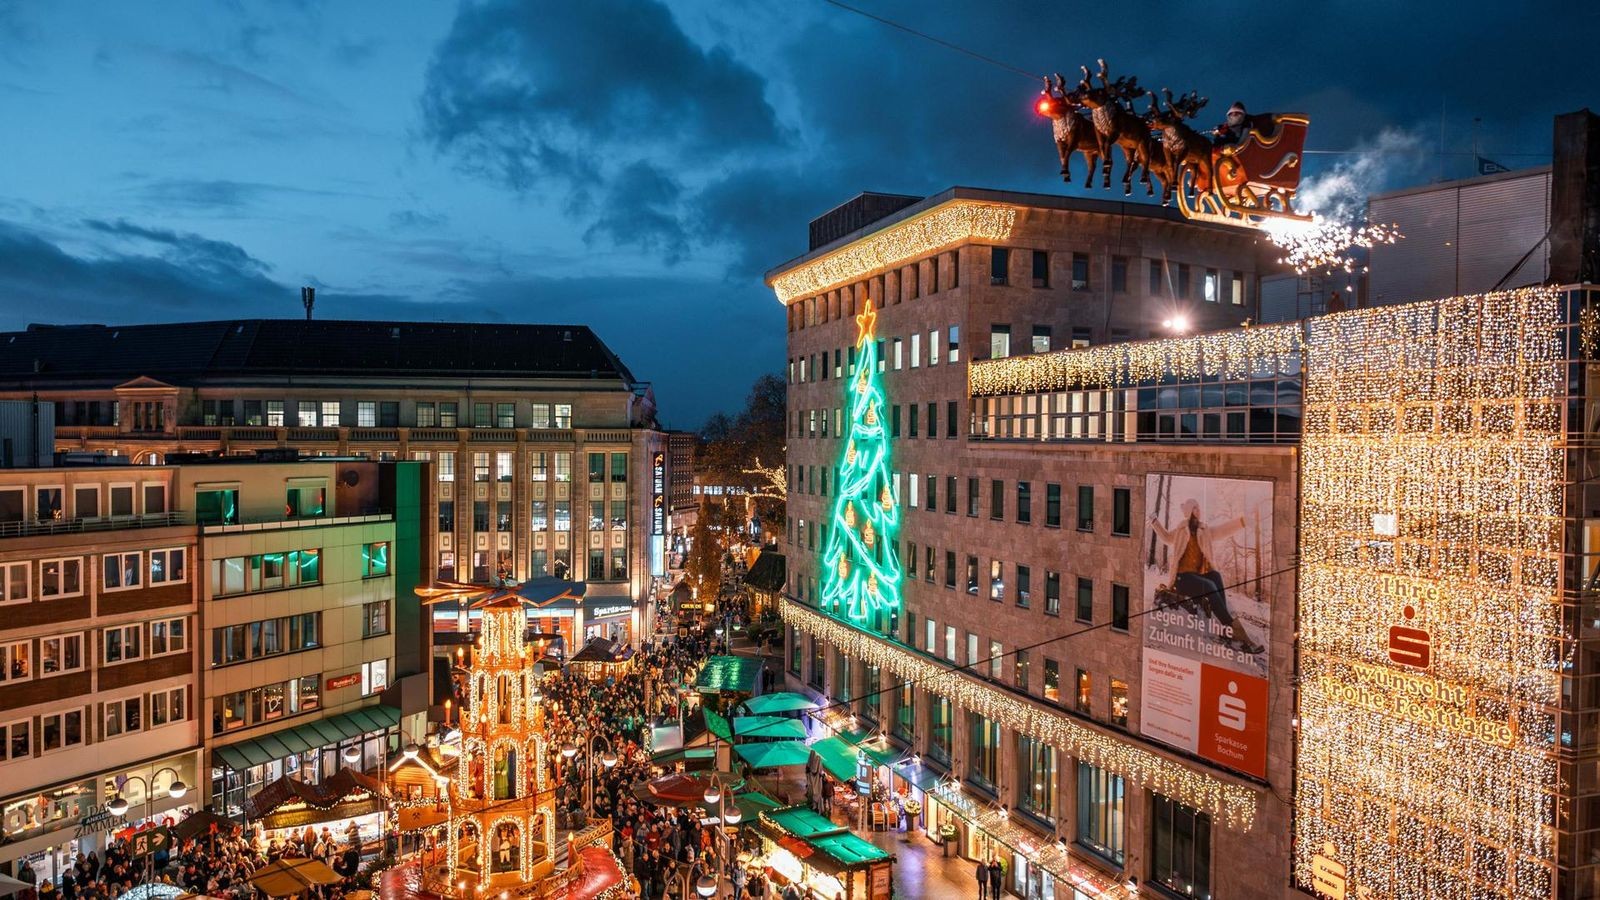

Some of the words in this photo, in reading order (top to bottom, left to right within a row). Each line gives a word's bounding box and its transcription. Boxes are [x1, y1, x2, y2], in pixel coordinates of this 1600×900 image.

[654, 466, 663, 493] SATURN
[654, 507, 663, 534] SATURN
[1382, 575, 1439, 601] Ihre
[1150, 607, 1184, 627] Legen
[1187, 614, 1205, 631] Sie
[1208, 618, 1233, 639] Ihre
[1149, 626, 1194, 651] Zukunft
[1197, 637, 1234, 660] heute
[1237, 650, 1257, 666] an.
[1353, 664, 1466, 705] wünscht
[1320, 676, 1384, 709] frohe
[1394, 695, 1512, 743] Festtage
[1215, 733, 1248, 751] Sparkasse
[1217, 744, 1245, 760] Bochum
[74, 814, 128, 839] ZIMMER
